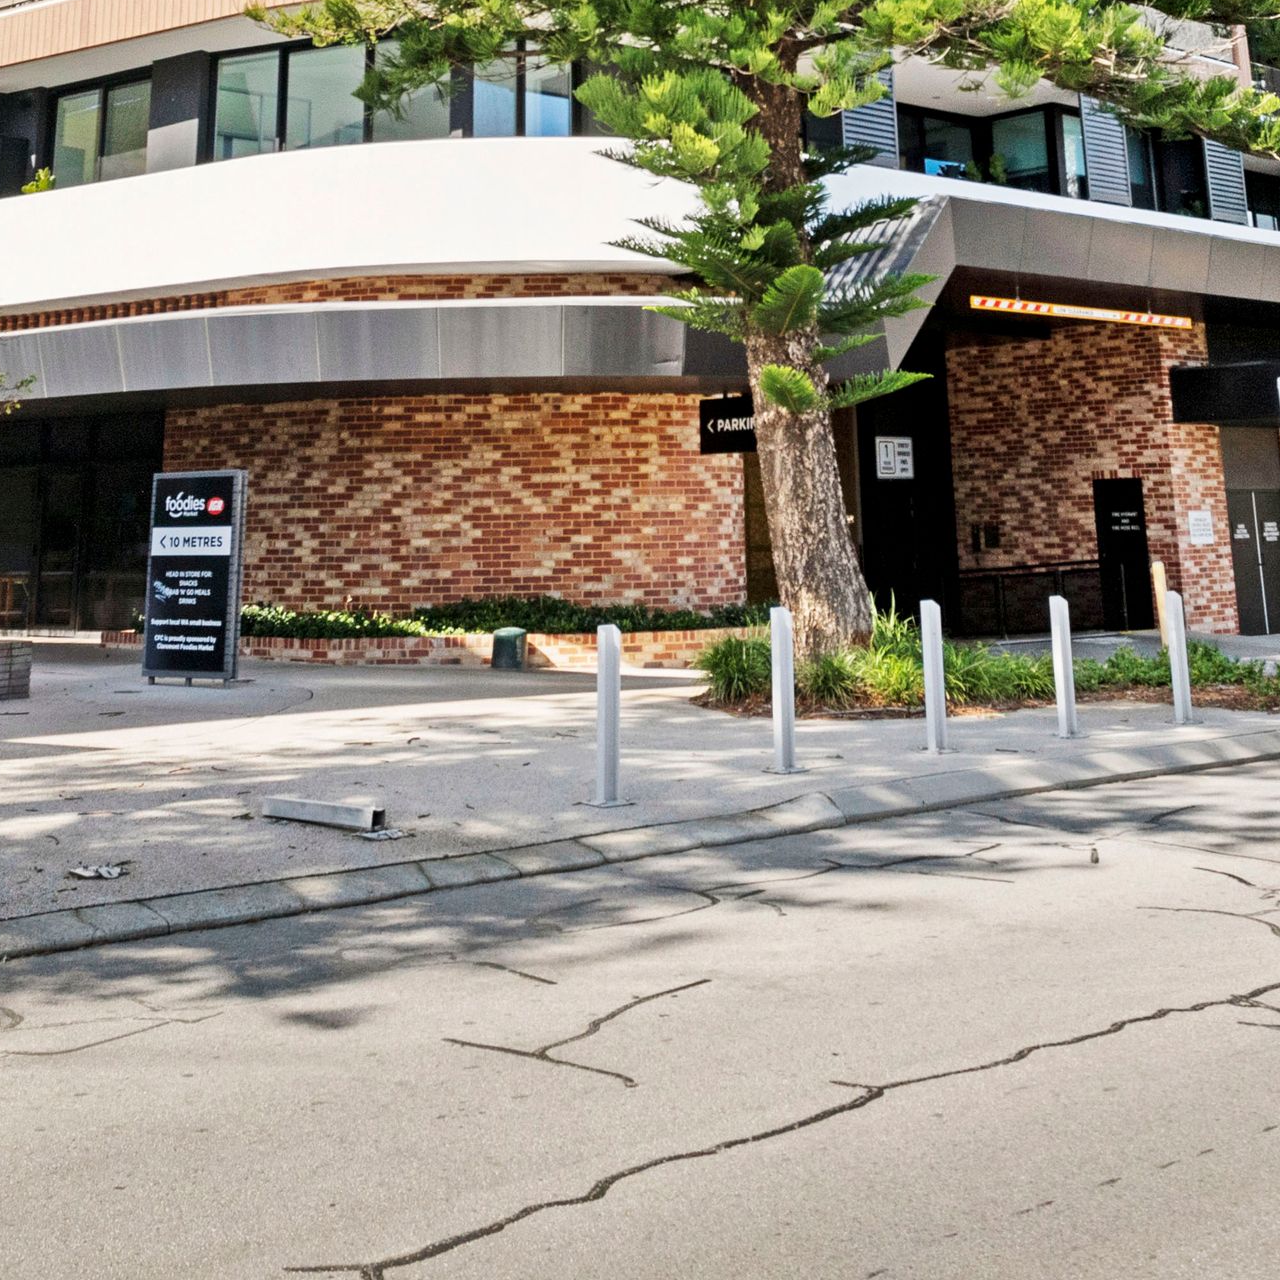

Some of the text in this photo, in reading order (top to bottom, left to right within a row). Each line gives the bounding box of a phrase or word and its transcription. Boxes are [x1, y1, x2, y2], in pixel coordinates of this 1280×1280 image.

[165, 492, 206, 512] foodies
[170, 536, 223, 548] 10 METRES
